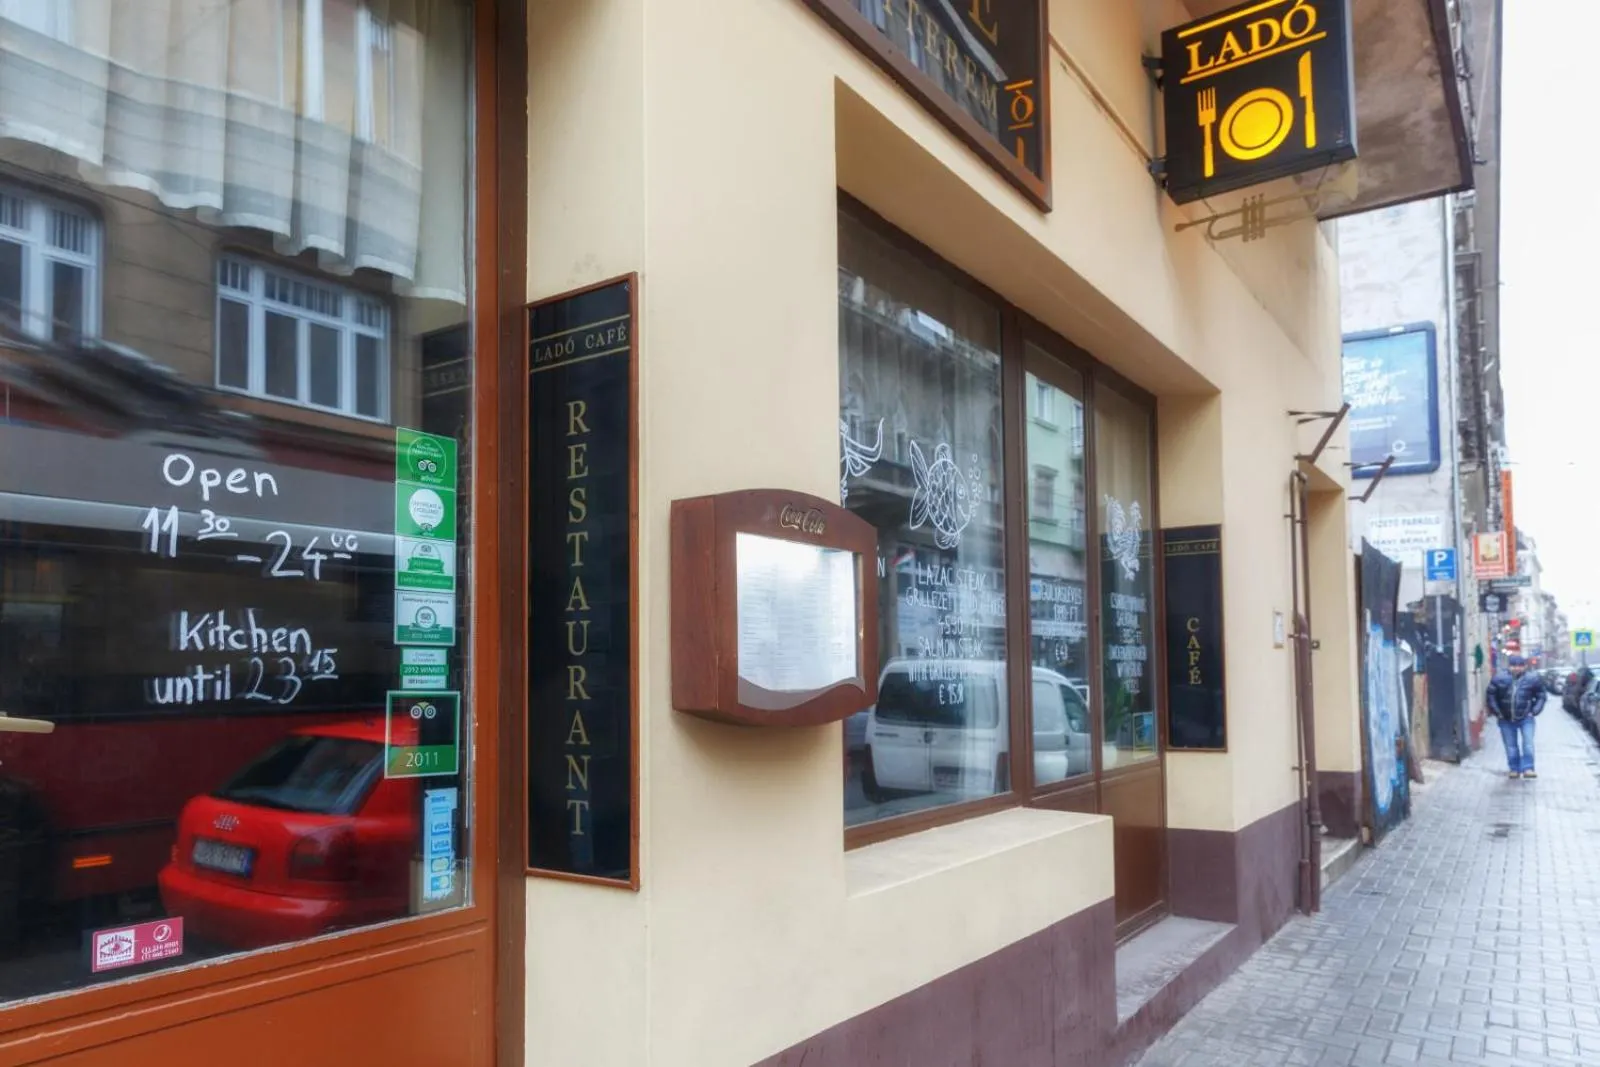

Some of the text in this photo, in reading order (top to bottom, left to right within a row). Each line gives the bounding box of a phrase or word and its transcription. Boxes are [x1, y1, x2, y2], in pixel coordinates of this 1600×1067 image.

[1186, 0, 1317, 74] LADÓ
[882, 0, 999, 120] TEREM
[535, 321, 628, 362] LADÓ CAFÉ
[163, 453, 279, 502] Open
[918, 561, 954, 587] LAZAC
[1433, 550, 1447, 567] P
[179, 607, 313, 656] Kitchen
[565, 400, 591, 836] RESTAURANT
[919, 636, 957, 658] SALMON
[1186, 616, 1202, 685] CAFÉ
[155, 663, 232, 705] until
[406, 751, 440, 768] 2011
